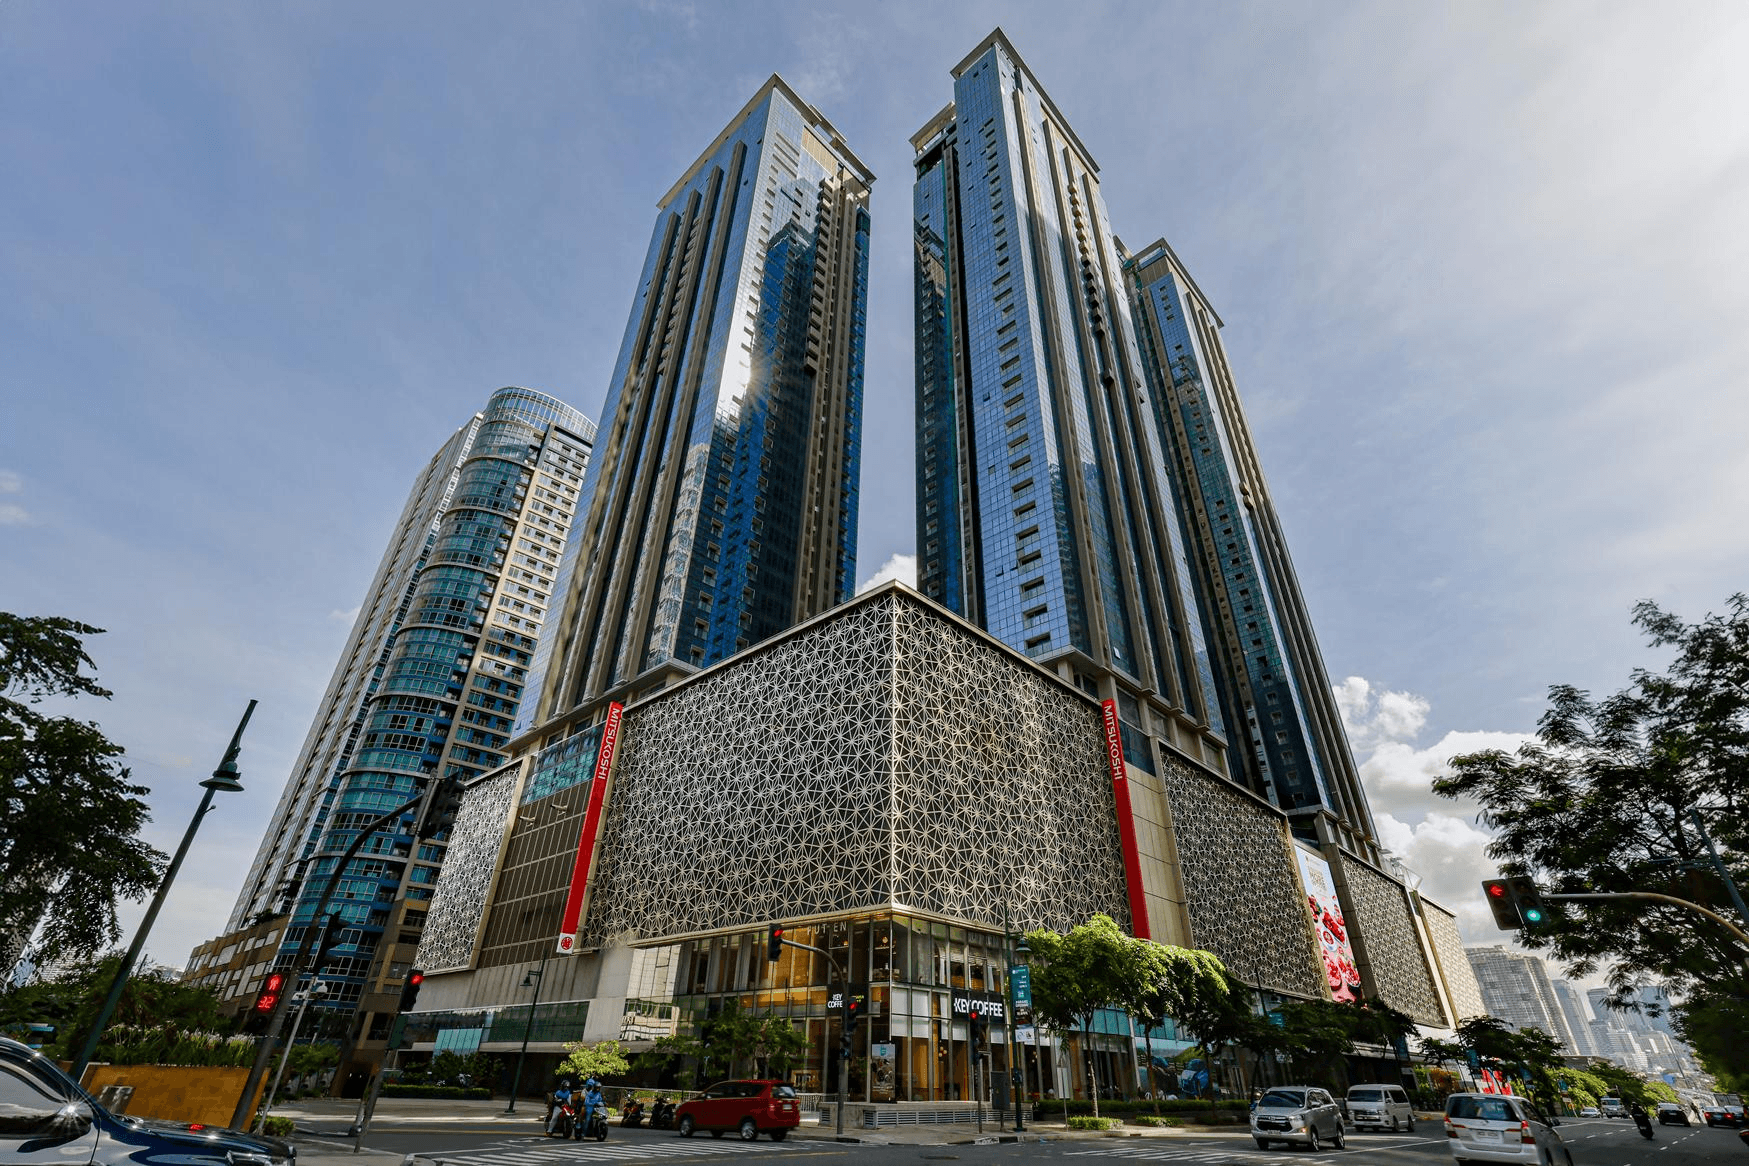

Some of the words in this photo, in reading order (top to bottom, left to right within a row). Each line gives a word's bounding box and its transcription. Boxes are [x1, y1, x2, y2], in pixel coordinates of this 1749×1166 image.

[598, 707, 621, 780] MITSUKOSHI
[1104, 705, 1123, 780] MITSUKOSHI
[807, 921, 847, 935] PUTEN
[827, 1000, 843, 1008] COFFE
[831, 993, 843, 1001] KEY
[953, 997, 970, 1014] KEY
[970, 999, 1004, 1017] COFFEE
